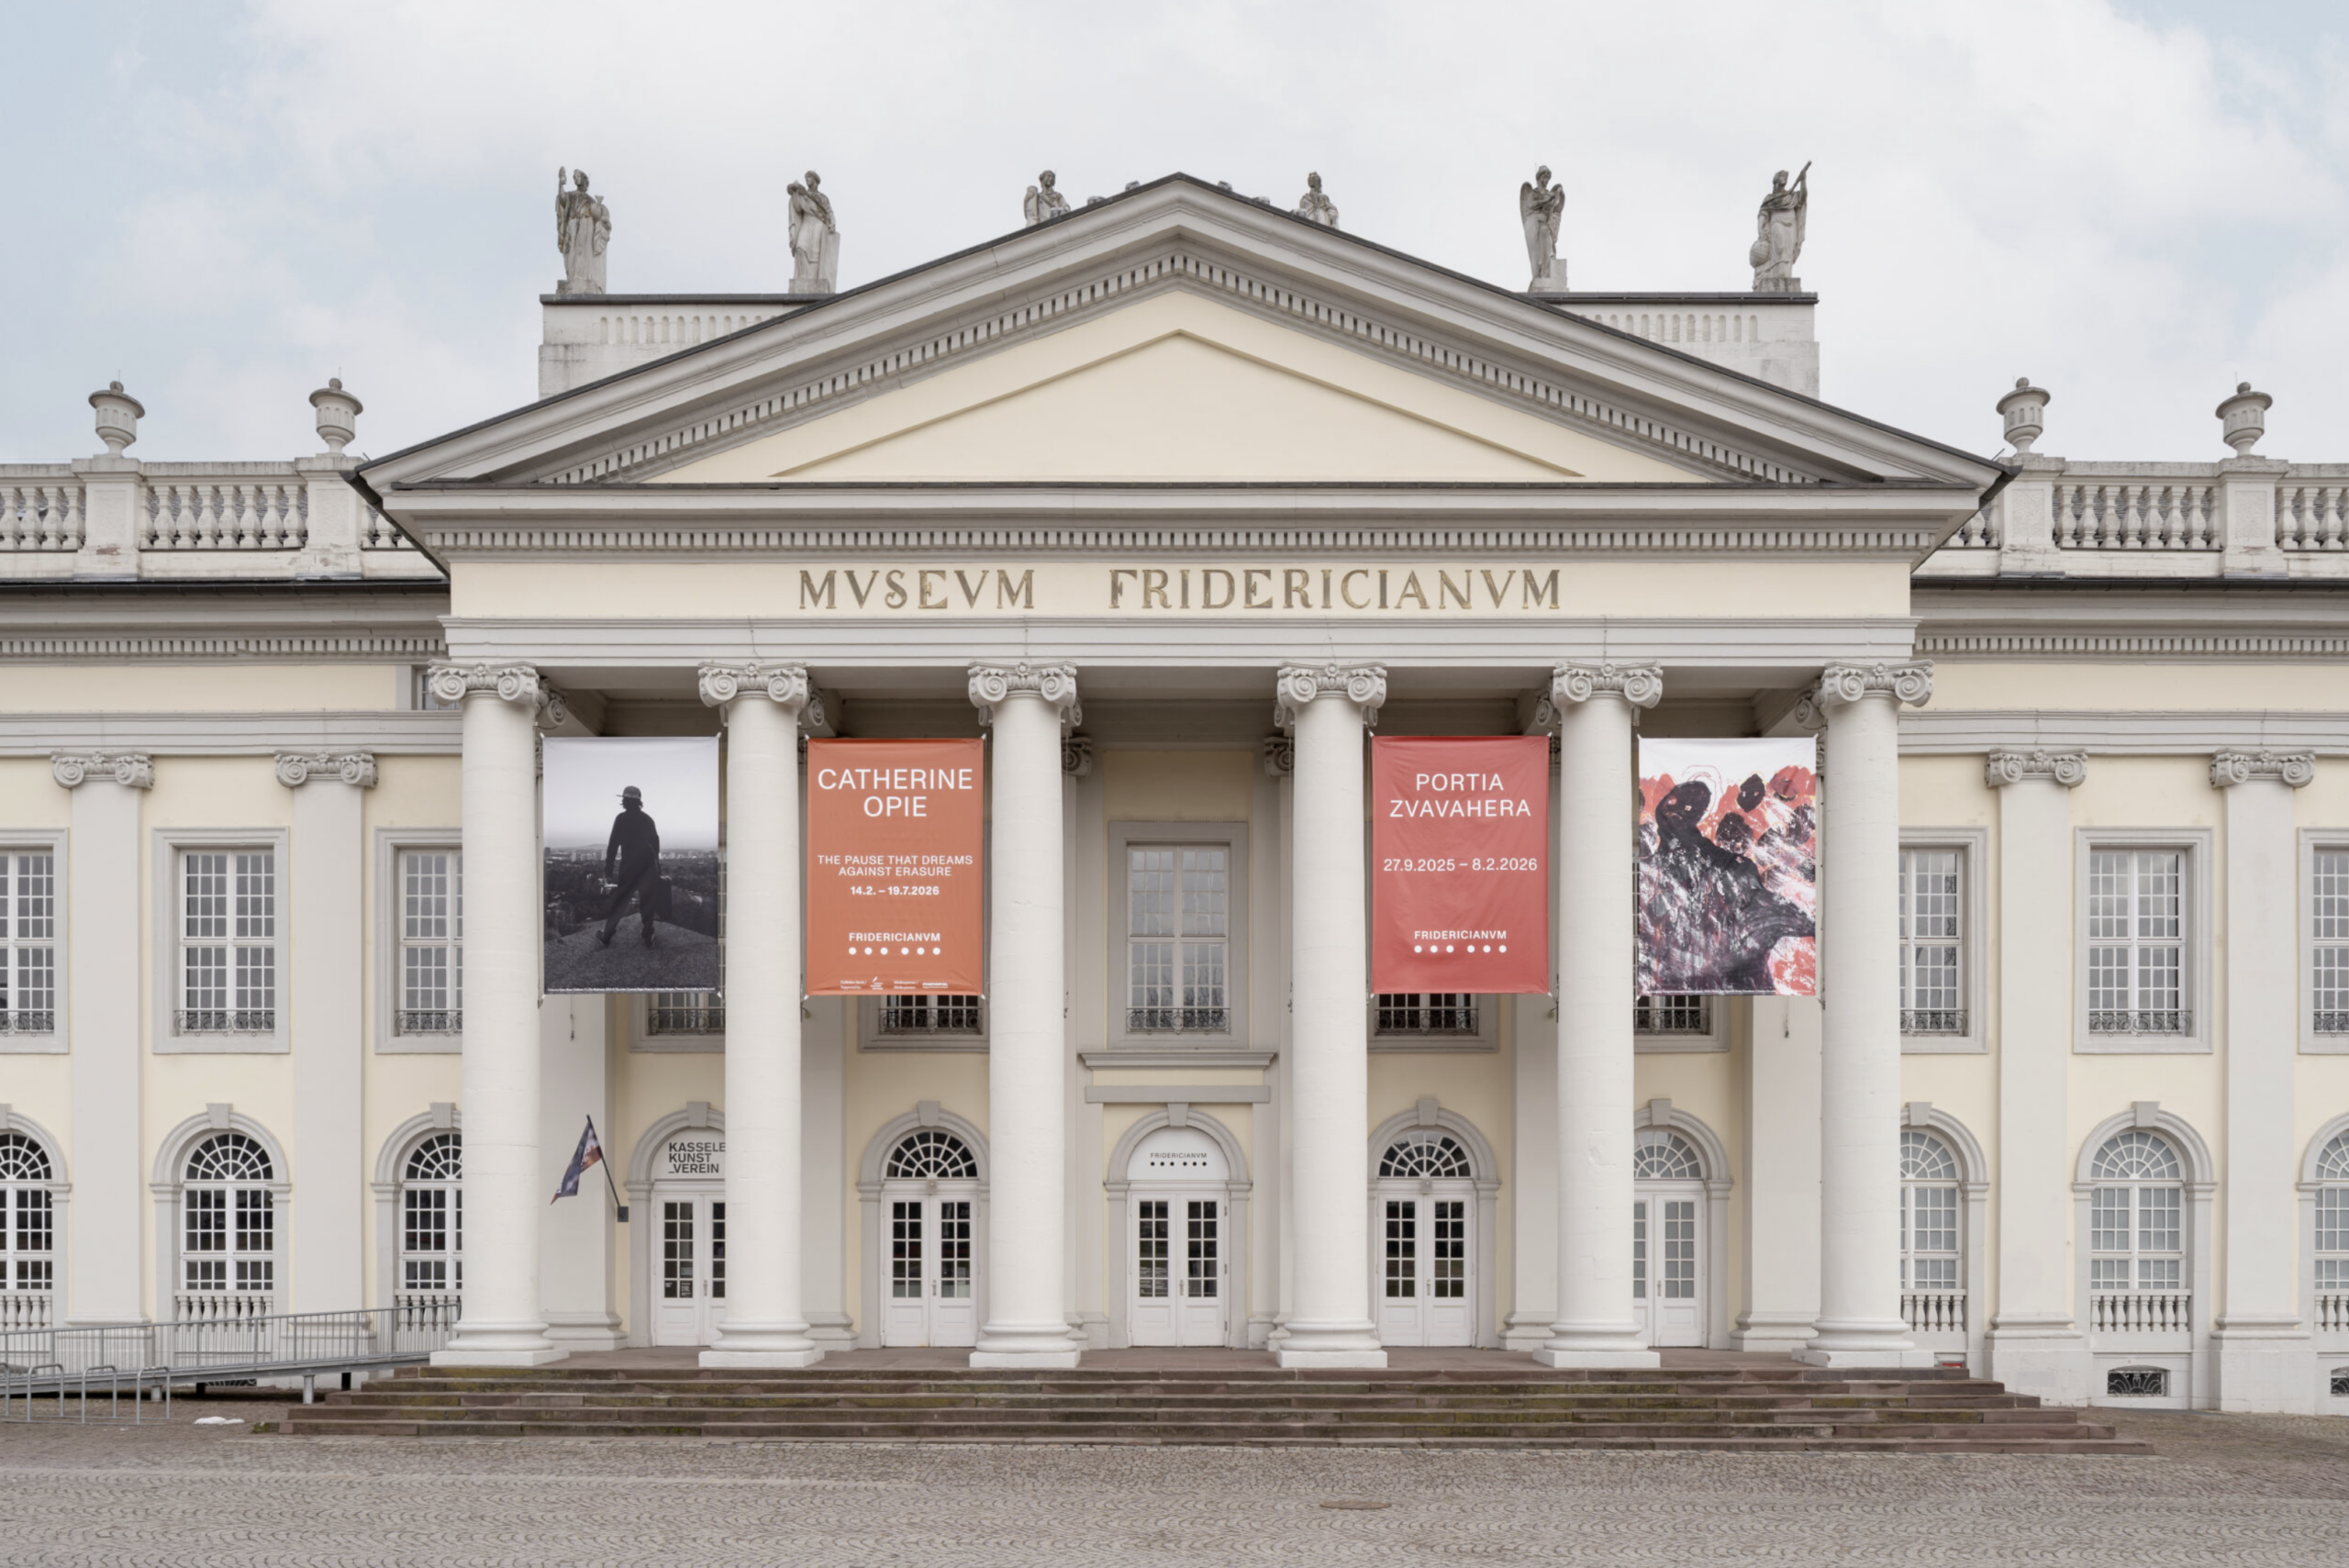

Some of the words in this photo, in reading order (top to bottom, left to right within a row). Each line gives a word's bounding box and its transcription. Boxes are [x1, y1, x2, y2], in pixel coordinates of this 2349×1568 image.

[799, 569, 1035, 609] MVSEVM
[1108, 569, 1561, 609] FRIDERICIANVM
[818, 768, 974, 790] CATHERINE
[1416, 773, 1505, 792] PORTIA
[863, 795, 927, 817] OPIE
[1389, 798, 1531, 817] ZVAVAHERA
[818, 854, 841, 865] THE
[845, 854, 885, 865] PAUSE
[888, 854, 918, 865] THAT
[922, 854, 974, 865] DREAMS
[1383, 858, 1455, 872] 27.9.2025
[1472, 857, 1538, 871] 8.2.2026
[839, 866, 892, 877] AGAINST
[896, 866, 952, 877] ERASURE
[850, 885, 876, 895] 14.2.
[887, 885, 940, 895] 19.7.2026
[849, 932, 941, 942] FRIDERICIANVM
[1414, 929, 1507, 940] FRIDERICIANVM
[669, 1142, 726, 1152] KASSELE
[668, 1152, 712, 1163] KUNST
